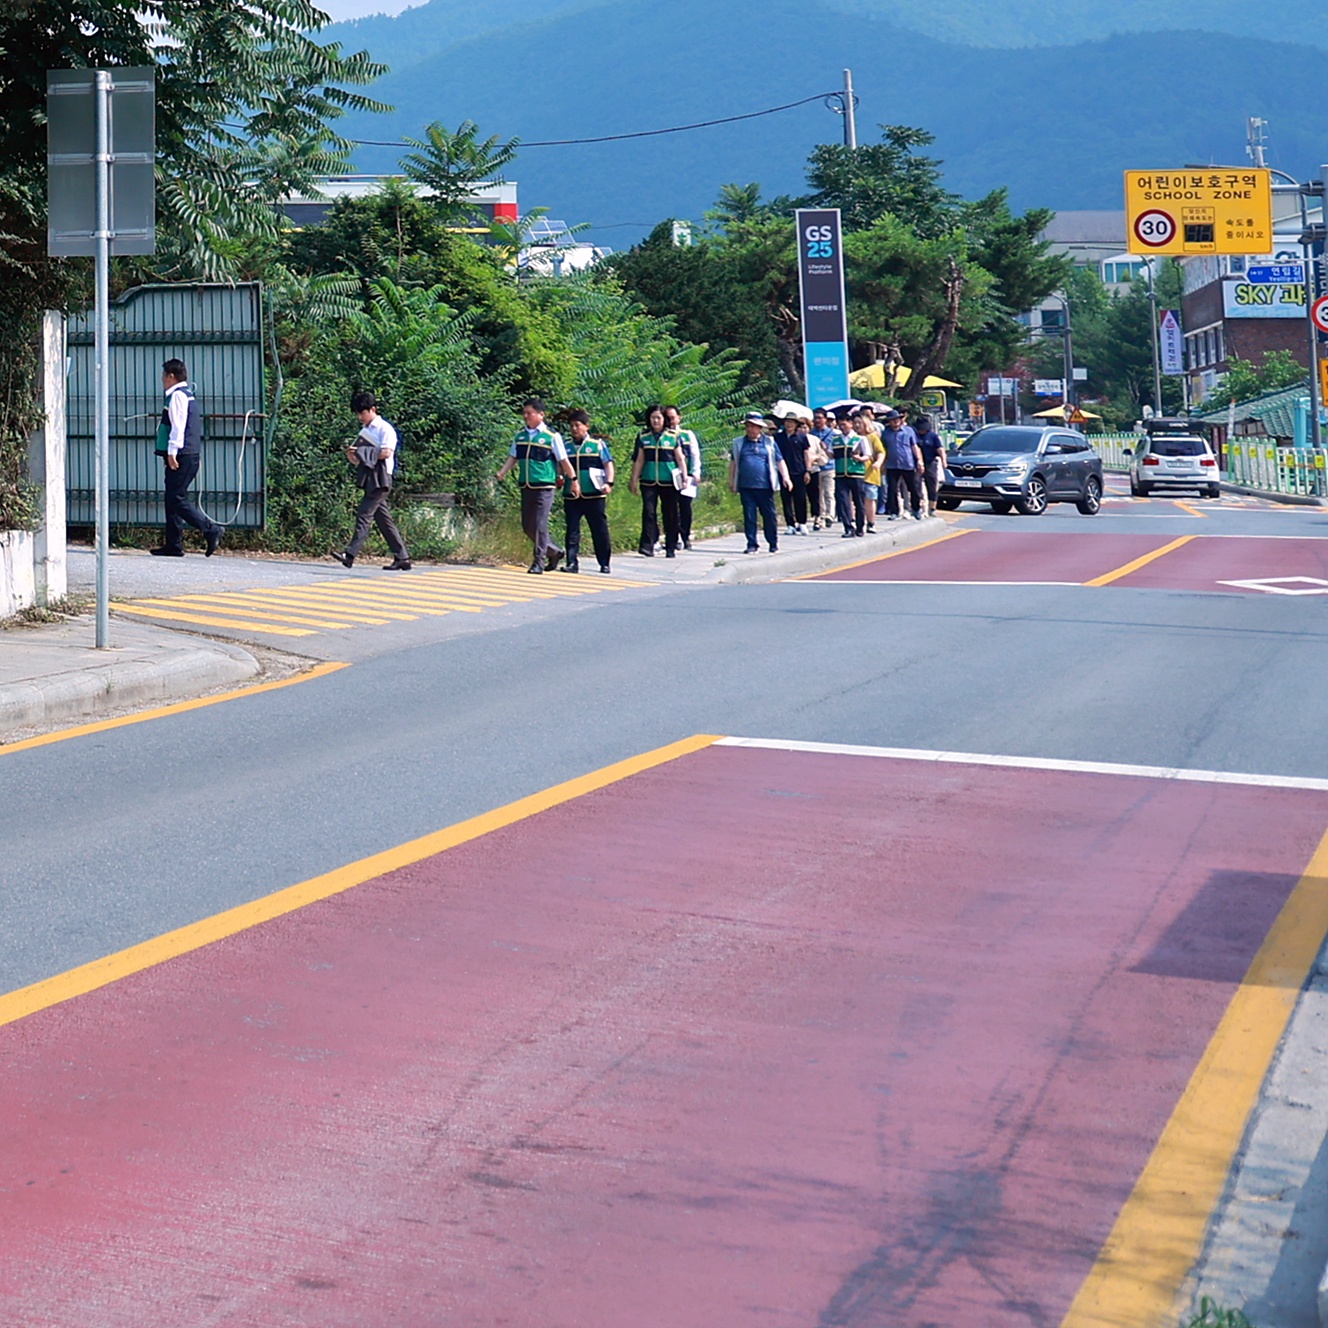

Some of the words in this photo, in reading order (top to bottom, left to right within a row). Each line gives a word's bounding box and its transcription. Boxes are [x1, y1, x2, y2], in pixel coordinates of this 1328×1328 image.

[1137, 174, 1257, 189] 어린이보호구역
[1143, 191, 1203, 200] SCHOOL
[1212, 190, 1252, 200] ZONE
[1141, 220, 1168, 236] 30
[1225, 218, 1255, 227] 속도를
[805, 225, 833, 242] GS
[1225, 230, 1265, 239] 줄이시오
[806, 241, 834, 259] 25
[1235, 283, 1277, 305] SKY
[1280, 284, 1307, 306] 과
